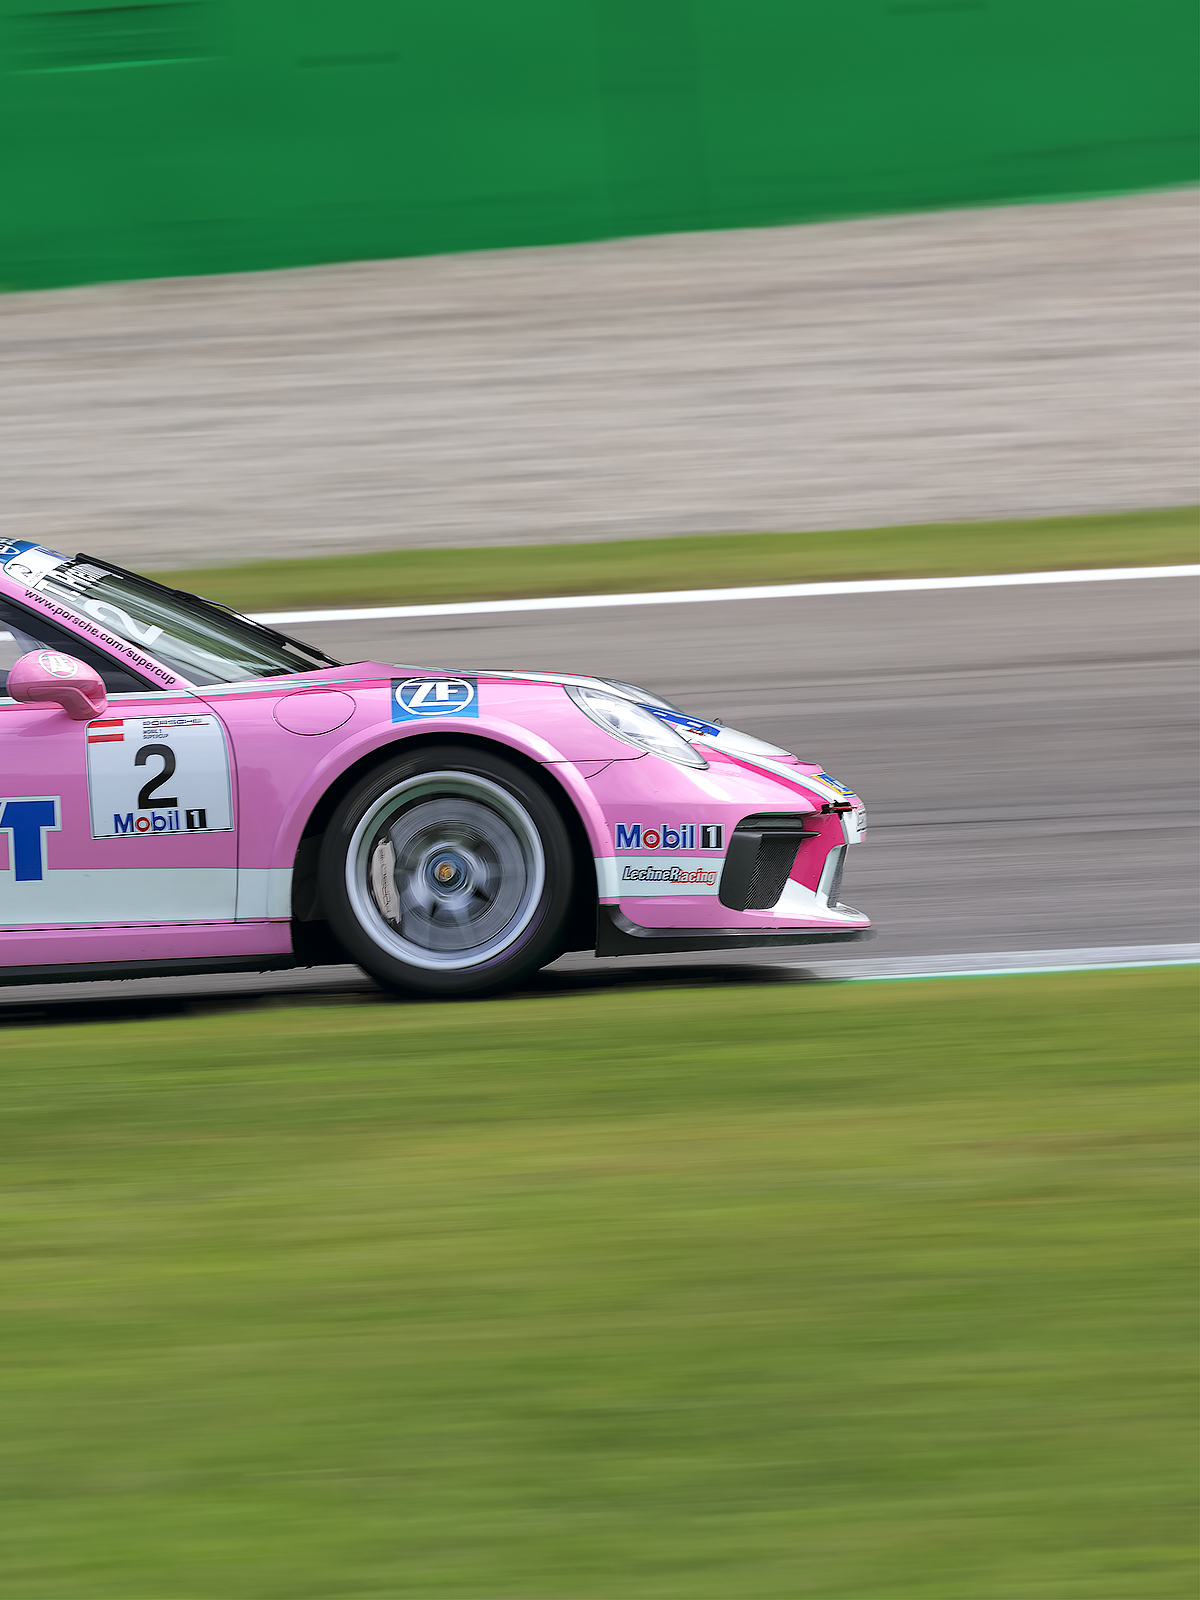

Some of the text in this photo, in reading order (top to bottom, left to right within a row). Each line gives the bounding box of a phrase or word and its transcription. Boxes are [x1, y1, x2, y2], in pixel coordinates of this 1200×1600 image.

[24, 589, 176, 685] www.porsche.com/supercup
[83, 599, 165, 645] 2
[402, 680, 470, 710] ZF
[135, 743, 178, 810] 2
[113, 809, 180, 834] Mobil
[615, 823, 696, 850] Mobil
